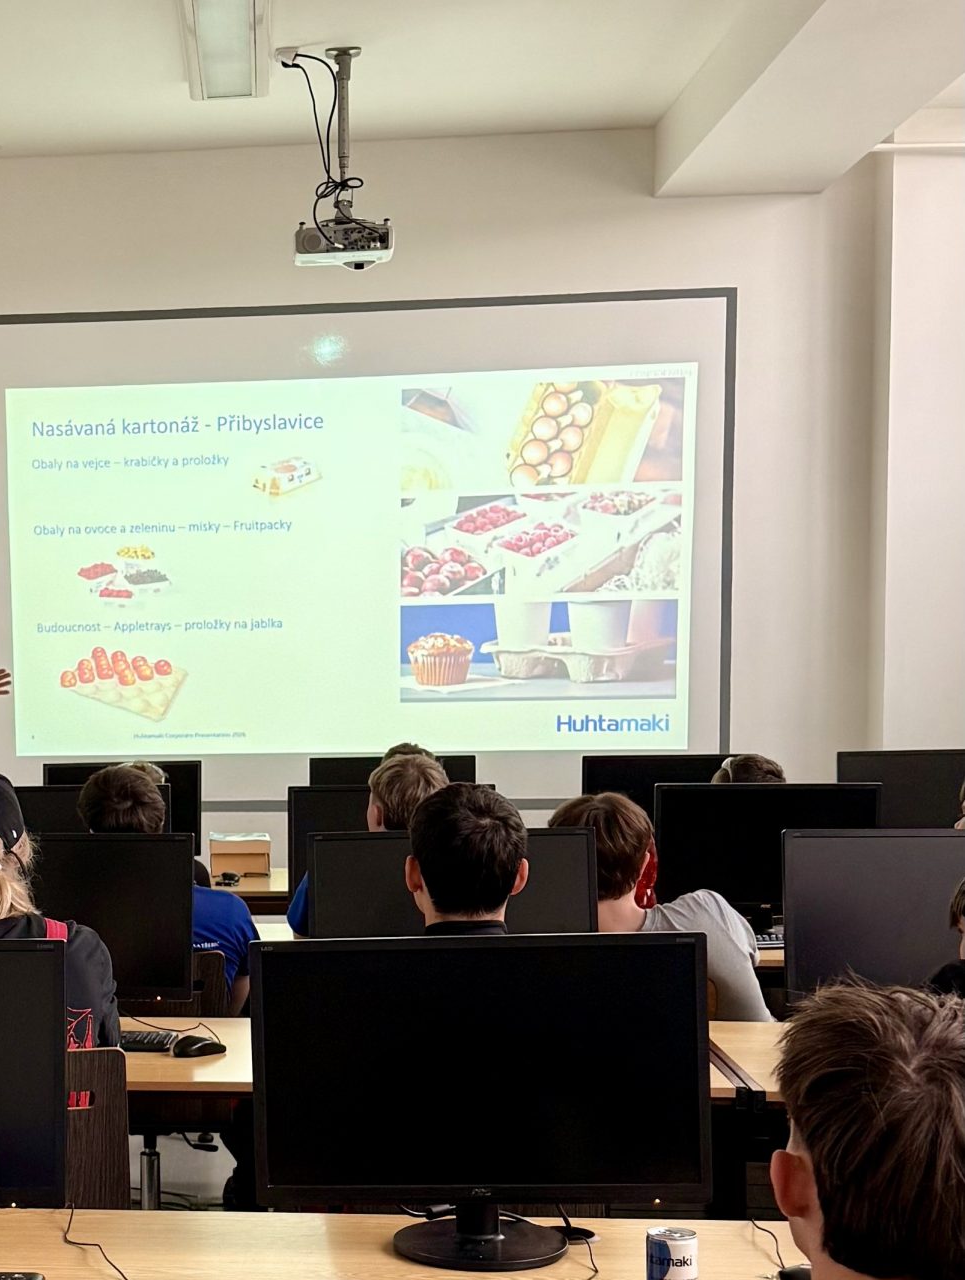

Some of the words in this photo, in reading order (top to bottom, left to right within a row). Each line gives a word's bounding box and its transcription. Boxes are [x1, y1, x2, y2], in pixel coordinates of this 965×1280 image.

[32, 419, 116, 437] Nasávaná
[122, 416, 199, 435] kartonáž
[217, 414, 324, 435] Přibyslavice
[32, 458, 63, 471] Obaly
[66, 461, 79, 469] na
[82, 458, 110, 471] vejce
[123, 456, 169, 470] krabičky
[182, 455, 229, 468] proložky
[34, 525, 64, 537] Obaly
[68, 527, 81, 535] na
[84, 526, 117, 534] ovoce
[120, 525, 126, 533] a
[129, 523, 176, 534] zeleninu
[189, 521, 220, 536] misky
[234, 520, 291, 534] Fruitpacky
[37, 622, 101, 633] Budoucnost
[114, 620, 172, 634] Appletrays
[185, 619, 231, 633] proložky
[234, 621, 247, 630] na
[250, 618, 283, 631] jablka
[556, 713, 670, 732] Huhtamaki
